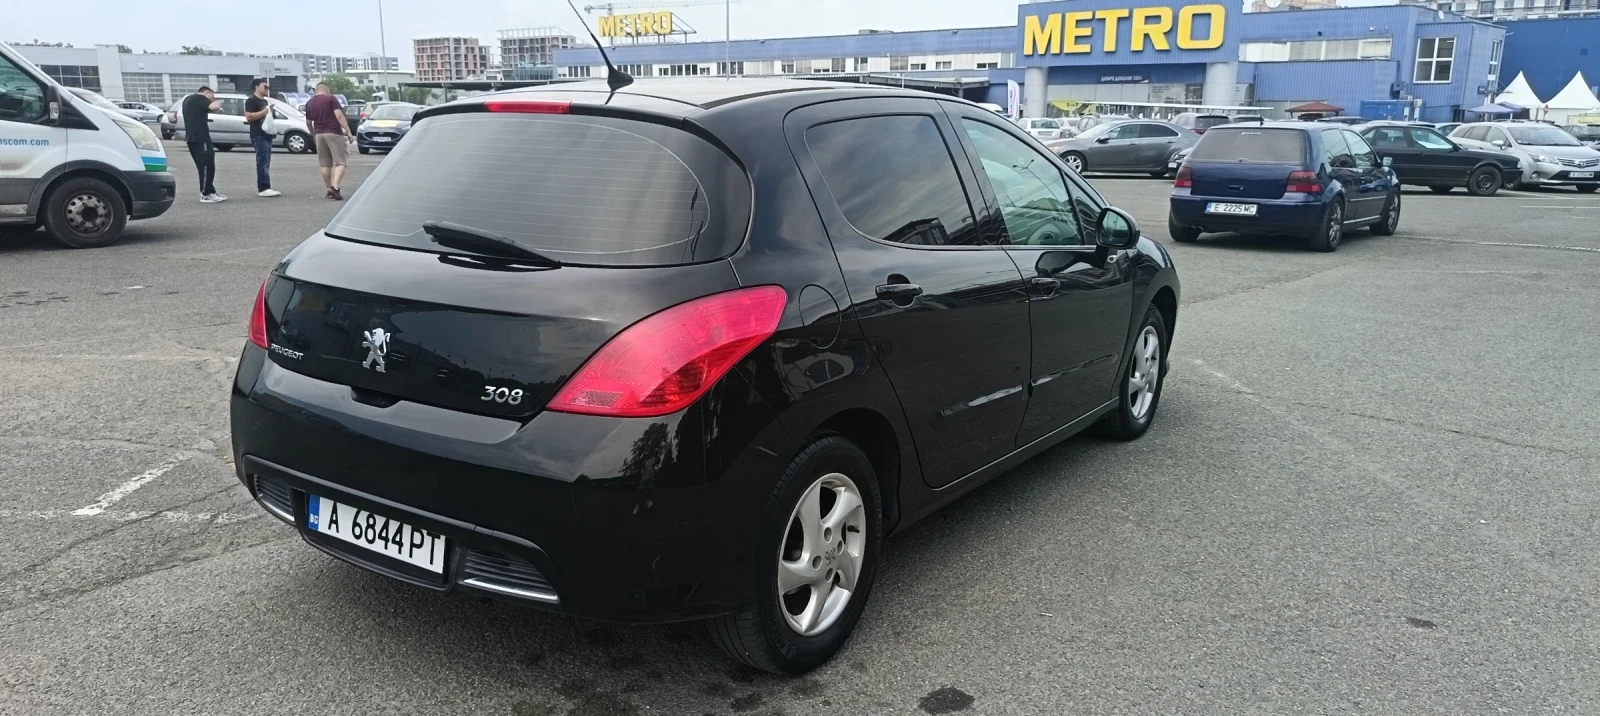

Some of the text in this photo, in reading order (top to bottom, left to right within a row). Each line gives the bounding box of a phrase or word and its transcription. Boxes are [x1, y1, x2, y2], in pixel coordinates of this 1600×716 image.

[598, 12, 672, 37] METRO
[1023, 4, 1226, 56] METRO
[271, 343, 304, 361] PEUGEOT
[480, 385, 524, 405] 308
[327, 500, 340, 533] A
